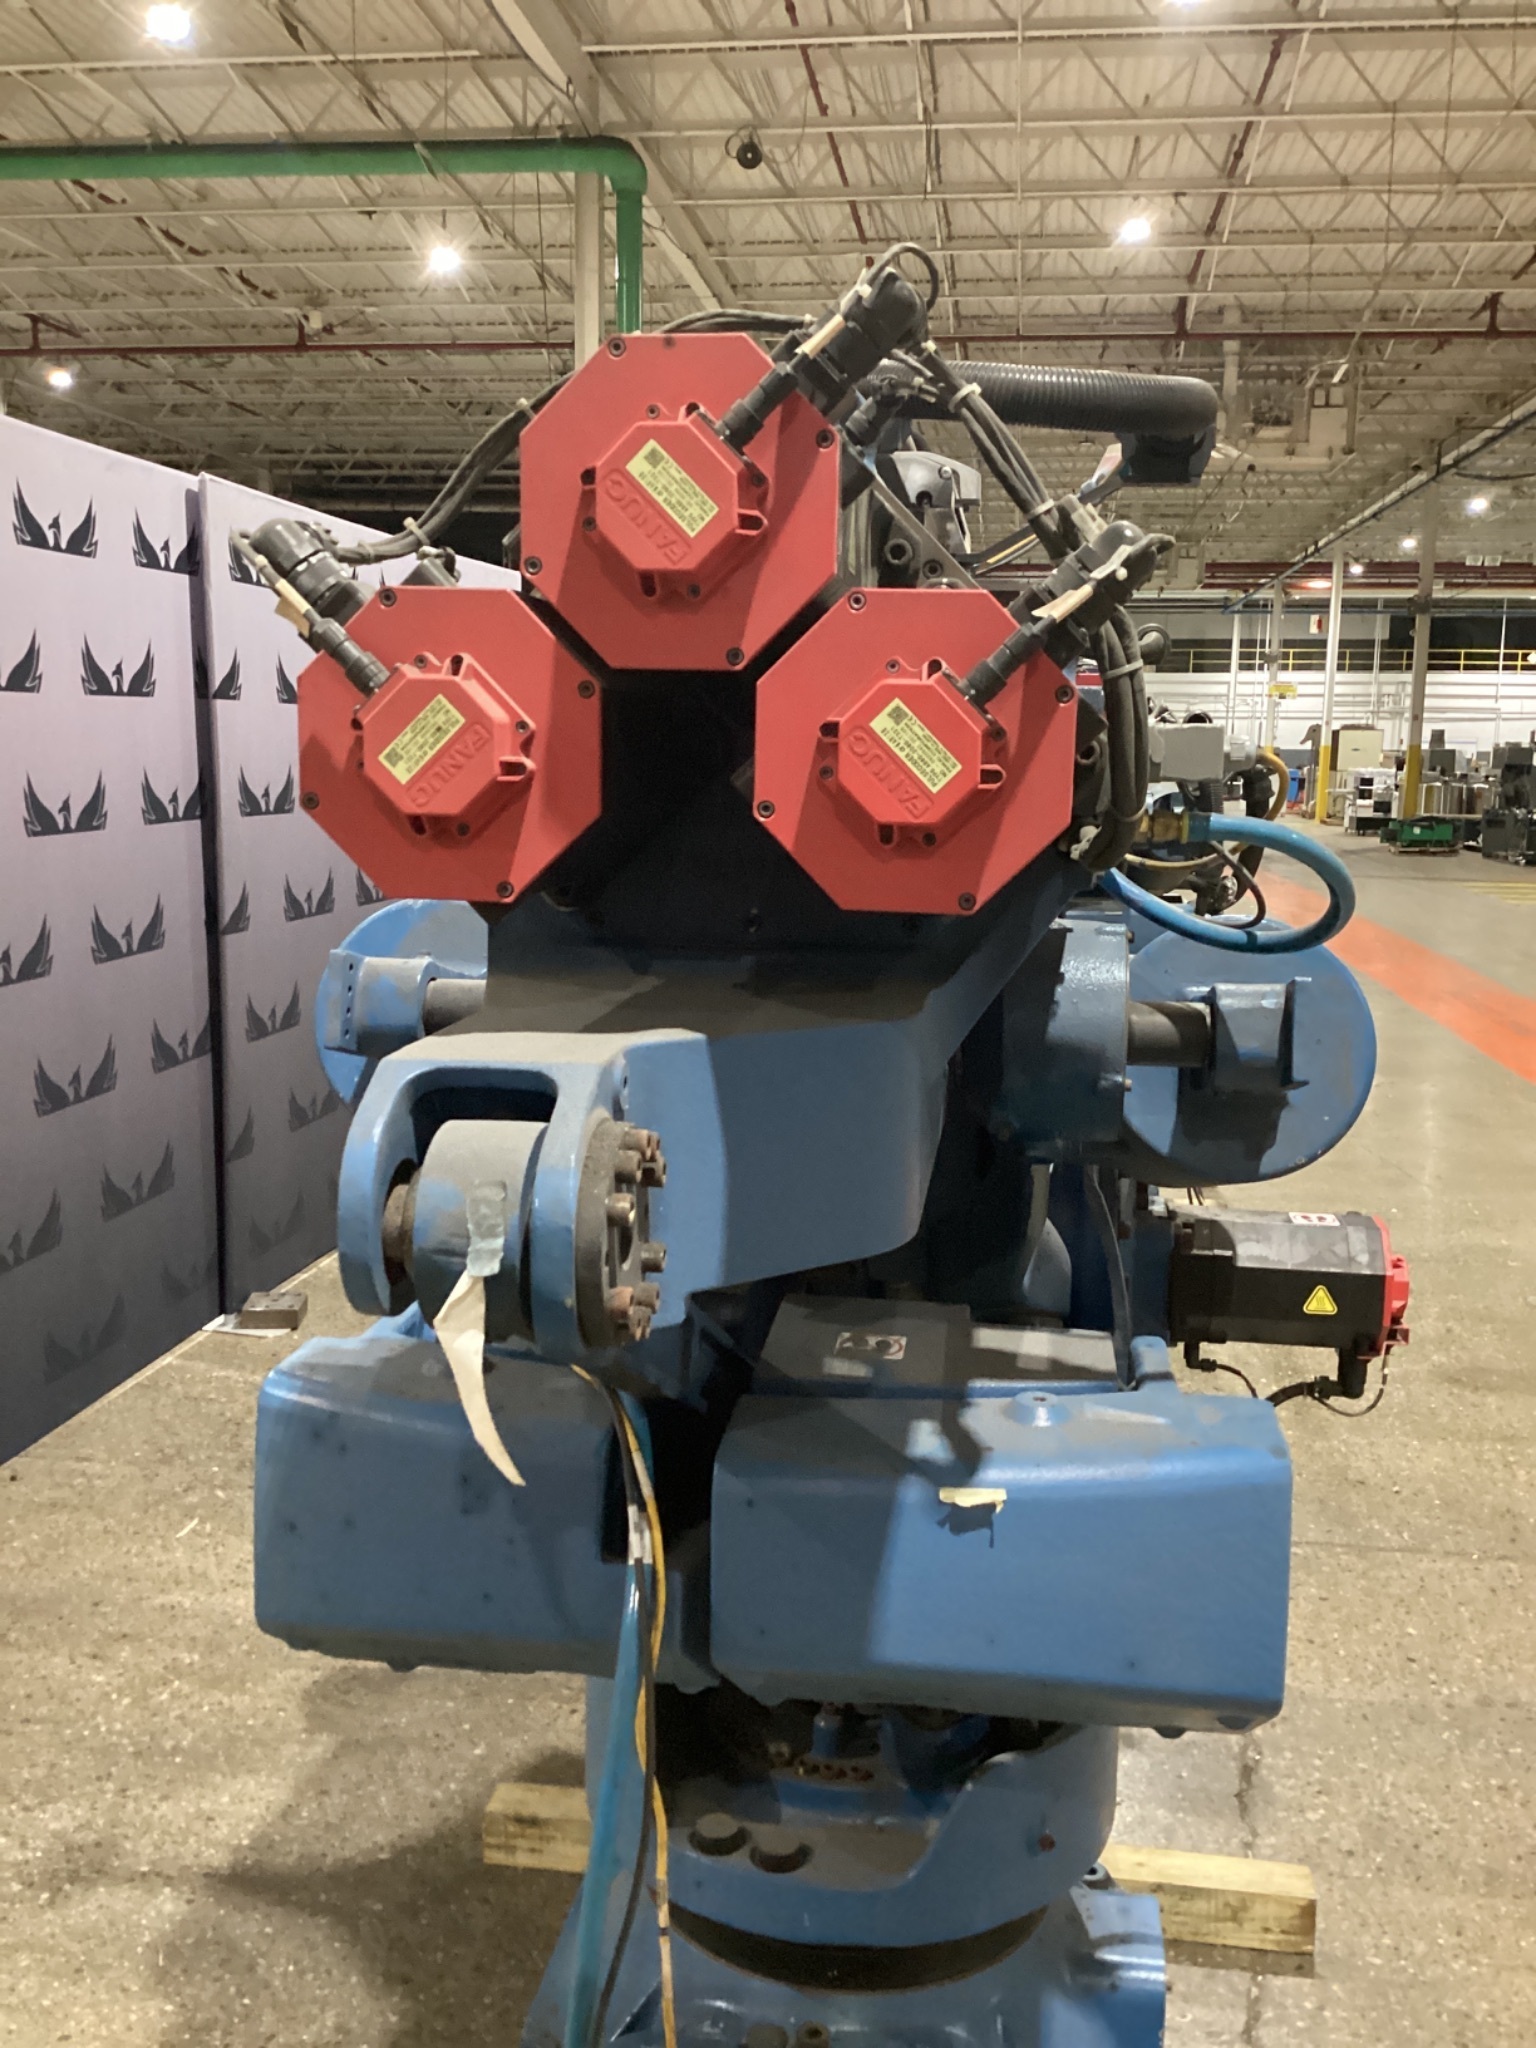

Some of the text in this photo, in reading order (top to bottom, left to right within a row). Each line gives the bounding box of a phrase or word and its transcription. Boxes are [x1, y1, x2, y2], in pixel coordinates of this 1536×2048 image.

[597, 473, 692, 566] FANUC
[404, 723, 492, 811] FANUC
[841, 728, 935, 820] FANUC
[902, 751, 939, 788] PULSECODER
